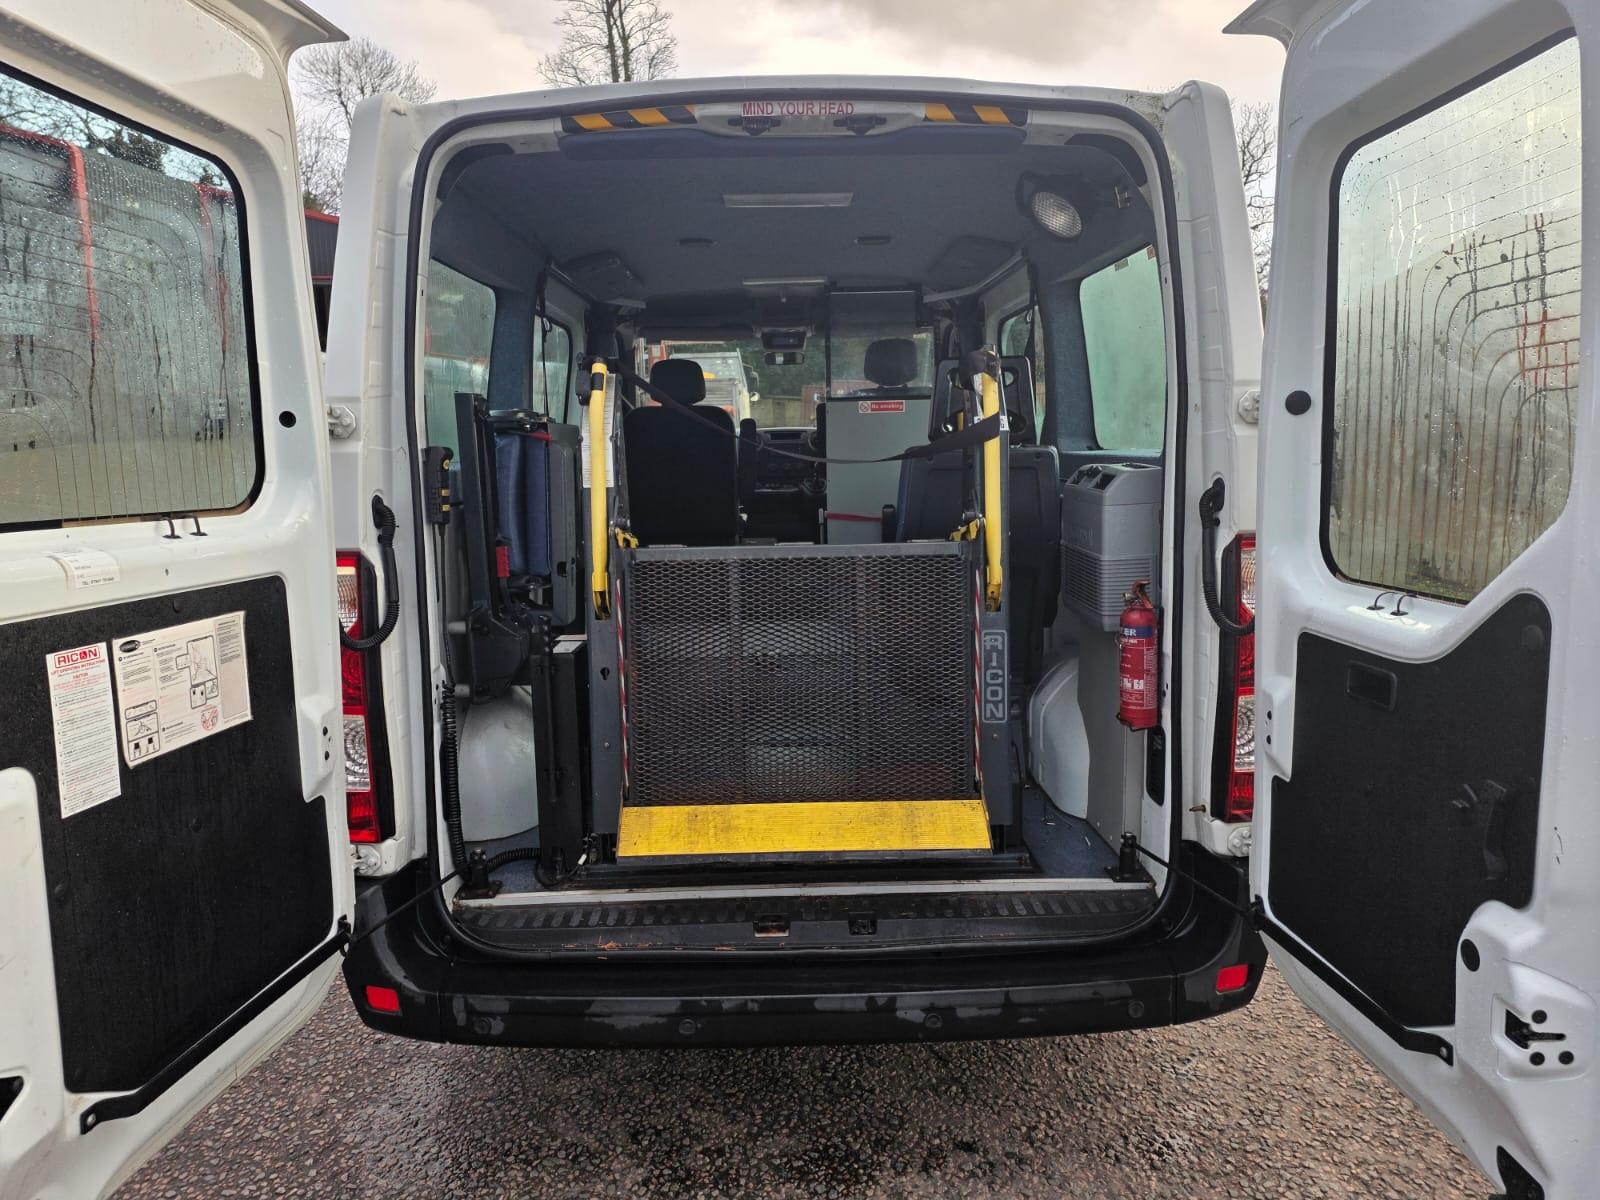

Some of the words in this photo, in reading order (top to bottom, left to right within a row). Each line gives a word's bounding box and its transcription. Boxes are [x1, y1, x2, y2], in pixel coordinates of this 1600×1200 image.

[742, 102, 774, 115] MIND
[778, 102, 815, 115] YOUR
[818, 102, 854, 115] HEAD
[57, 648, 98, 666] RICON
[985, 635, 1004, 719] RICON
